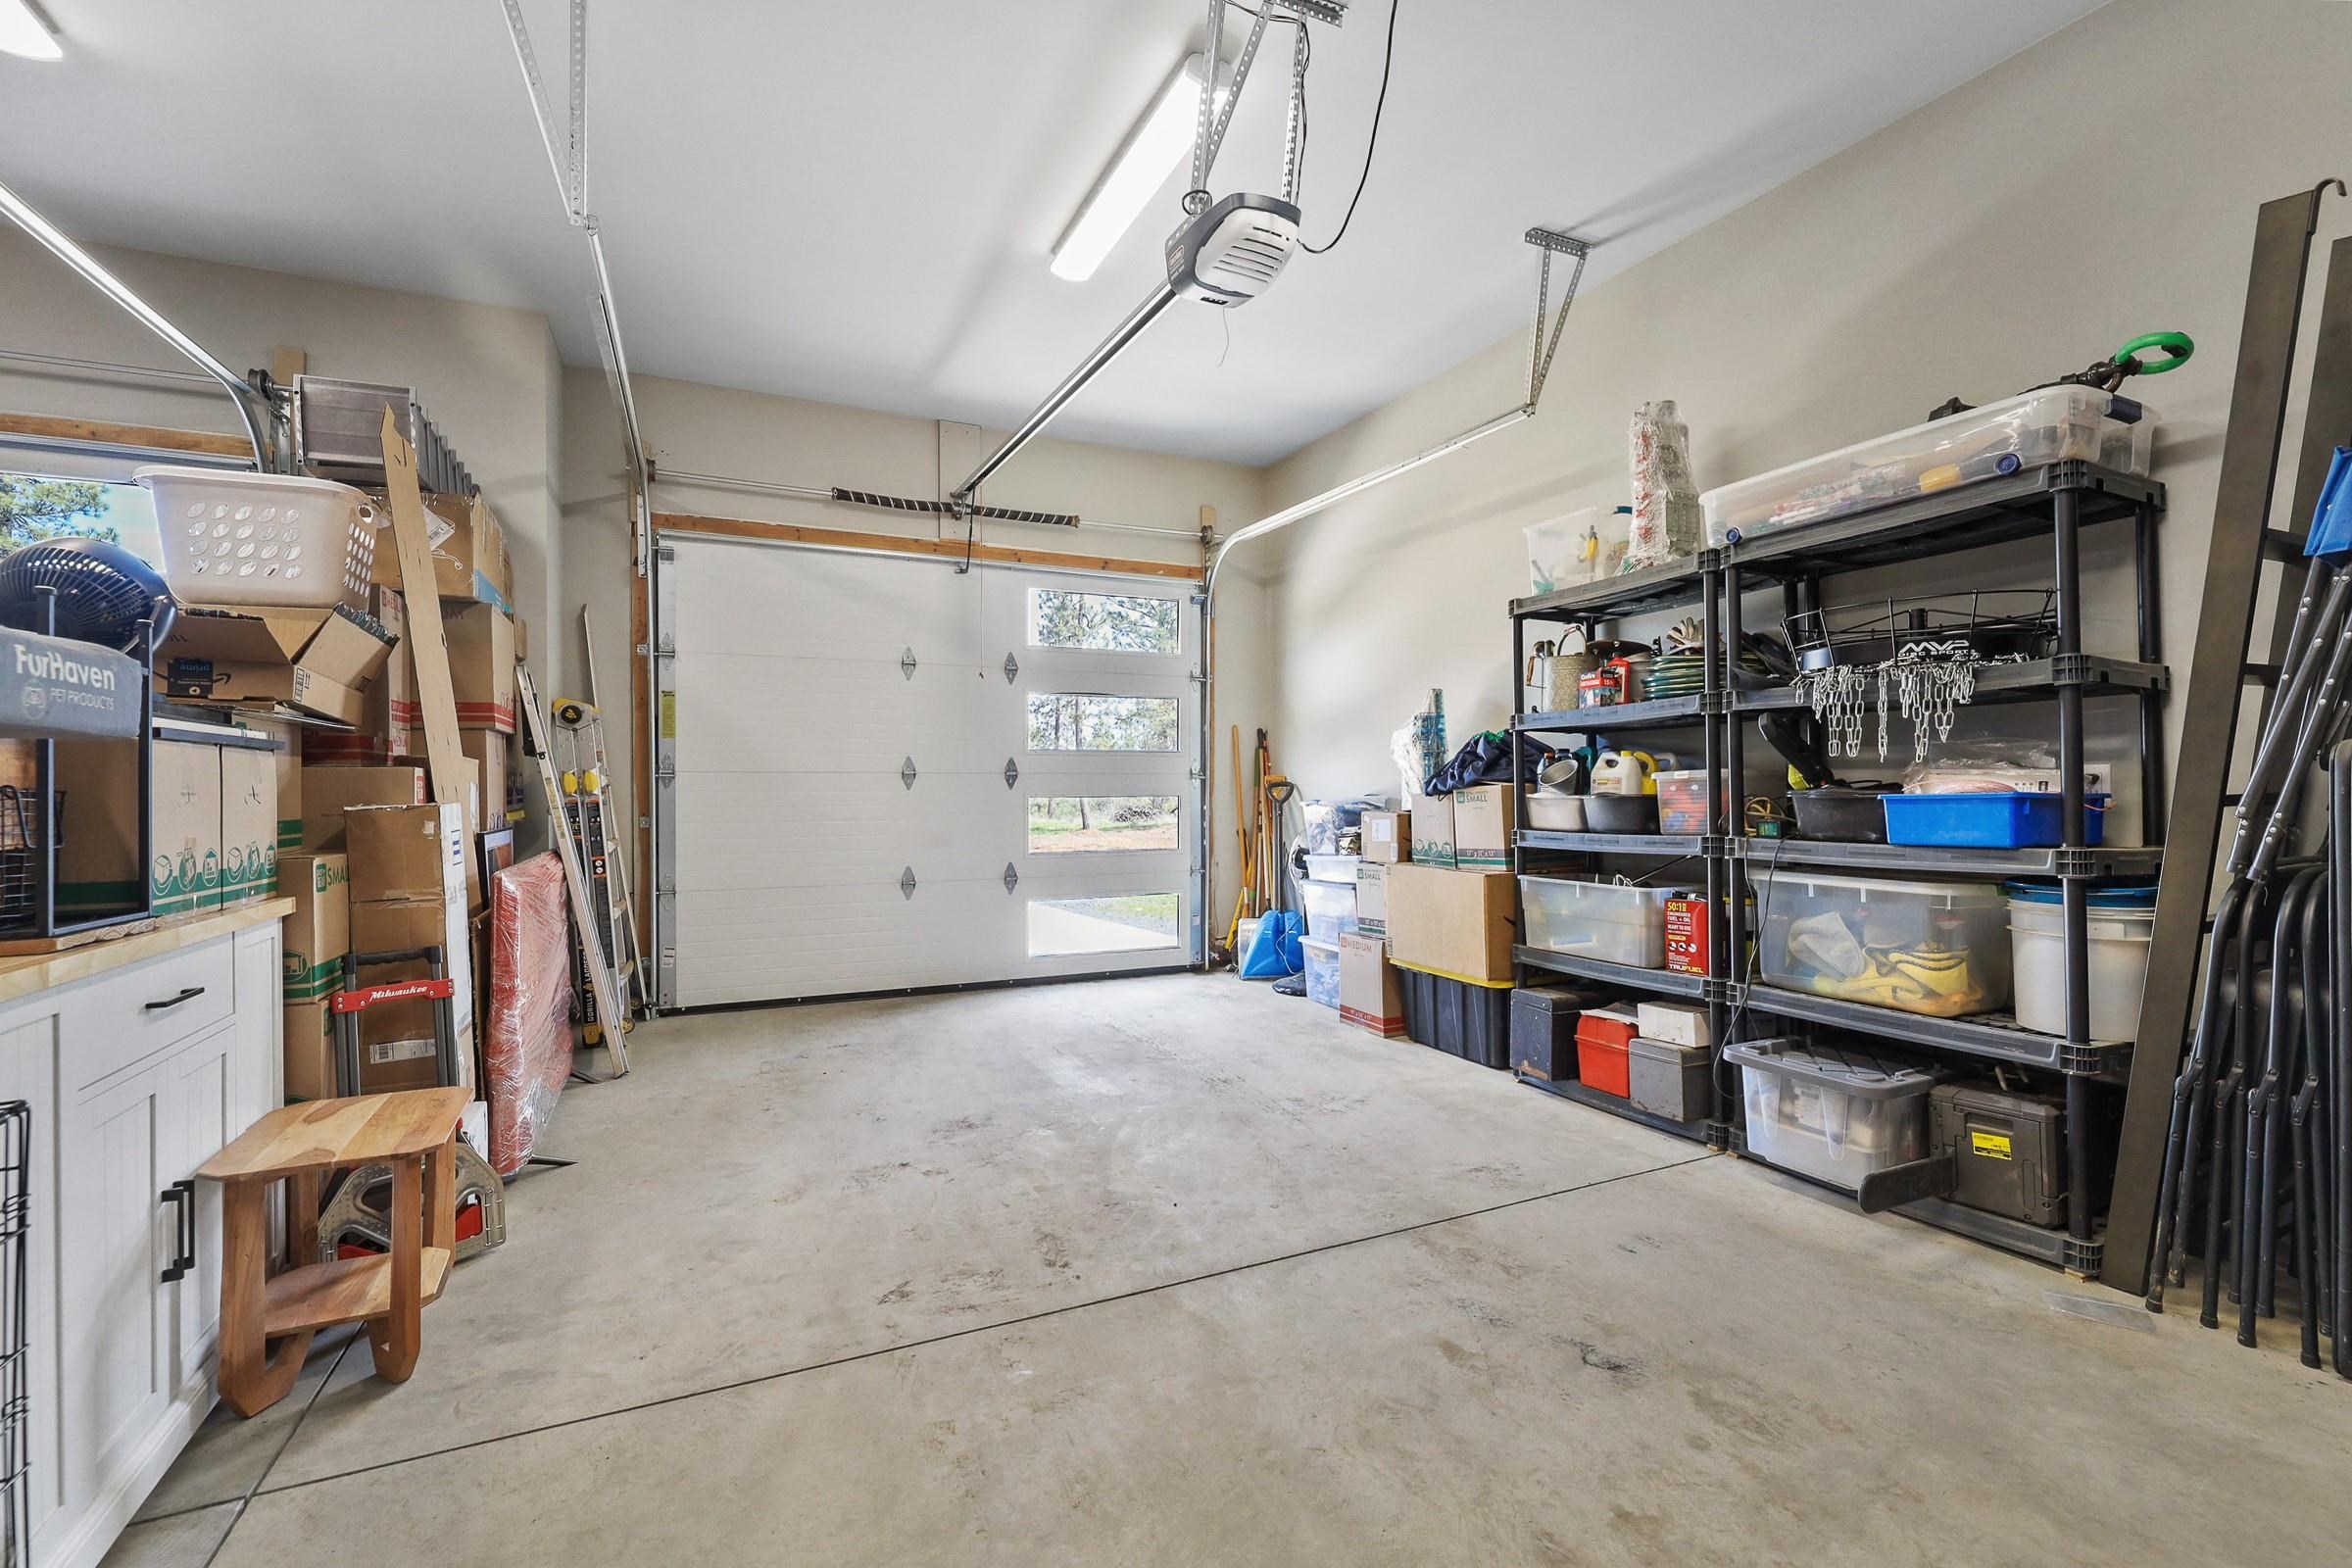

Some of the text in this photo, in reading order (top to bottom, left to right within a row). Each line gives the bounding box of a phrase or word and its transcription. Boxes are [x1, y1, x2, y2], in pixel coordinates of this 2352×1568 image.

[1898, 640, 1969, 653] MVP
[14, 644, 116, 691] FurHaven
[50, 687, 116, 710] PET PRODUCTS
[327, 865, 350, 886] SMAL
[1364, 871, 1381, 880] SMALL
[1668, 903, 1682, 911] 50:1
[1347, 940, 1372, 953] MEDIUM
[1669, 964, 1704, 973] TRUFUEL
[369, 986, 428, 1002] Milwaukee
[586, 992, 595, 1022] GORILLA
